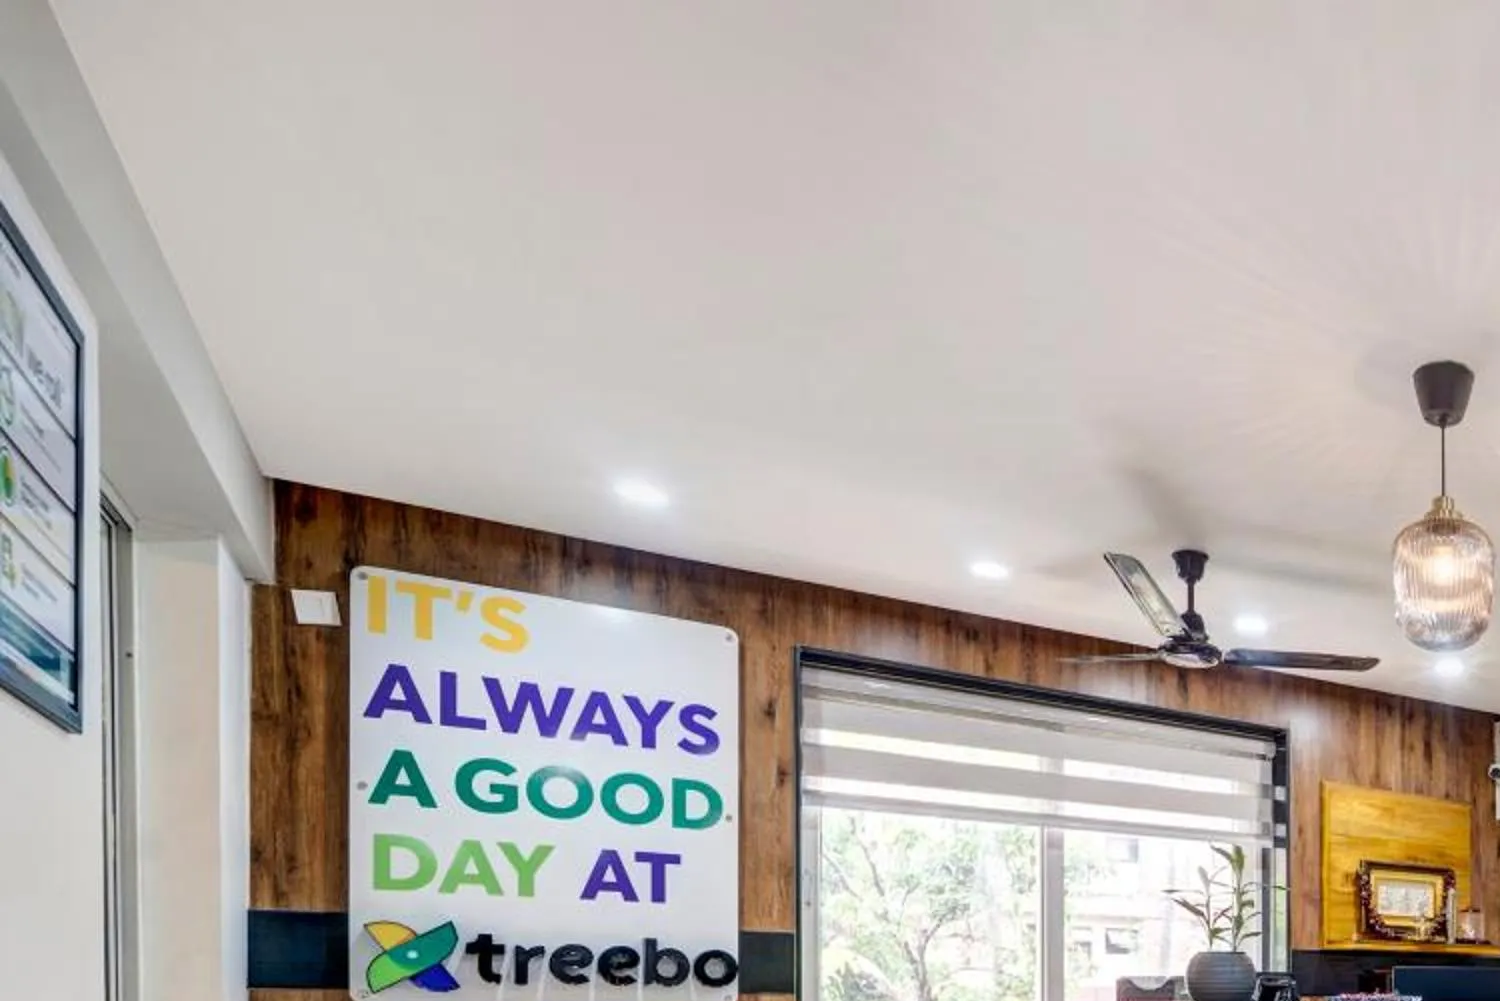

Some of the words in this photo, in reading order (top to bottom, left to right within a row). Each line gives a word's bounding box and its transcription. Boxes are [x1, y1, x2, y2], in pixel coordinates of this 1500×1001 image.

[367, 575, 530, 653] IT'S
[363, 664, 721, 755] ALWAYS
[367, 749, 438, 808] A
[454, 757, 723, 830] GOOD
[372, 833, 556, 898] DAY
[579, 849, 682, 904] AT
[465, 932, 739, 989] treebo
